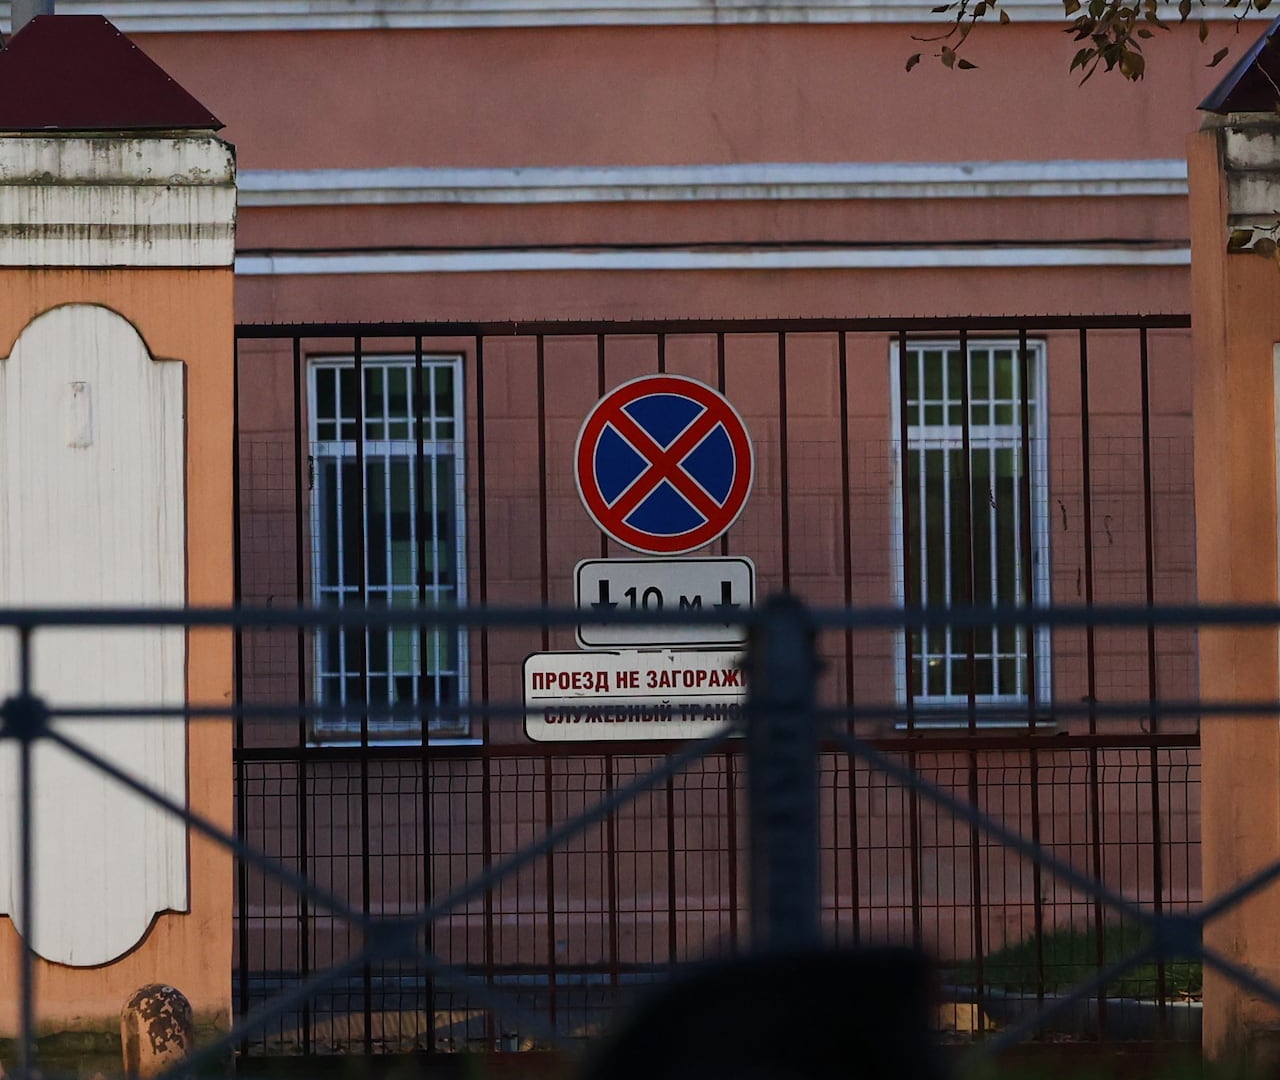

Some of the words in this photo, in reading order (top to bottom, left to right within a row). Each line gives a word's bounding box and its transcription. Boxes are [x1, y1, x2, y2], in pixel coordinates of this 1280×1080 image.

[532, 670, 610, 692] ПРОЕЗД
[616, 670, 640, 689] НЕ
[543, 699, 673, 724] СЛУЖЕБНЫЙ
[678, 703, 746, 722] ТРАНС
